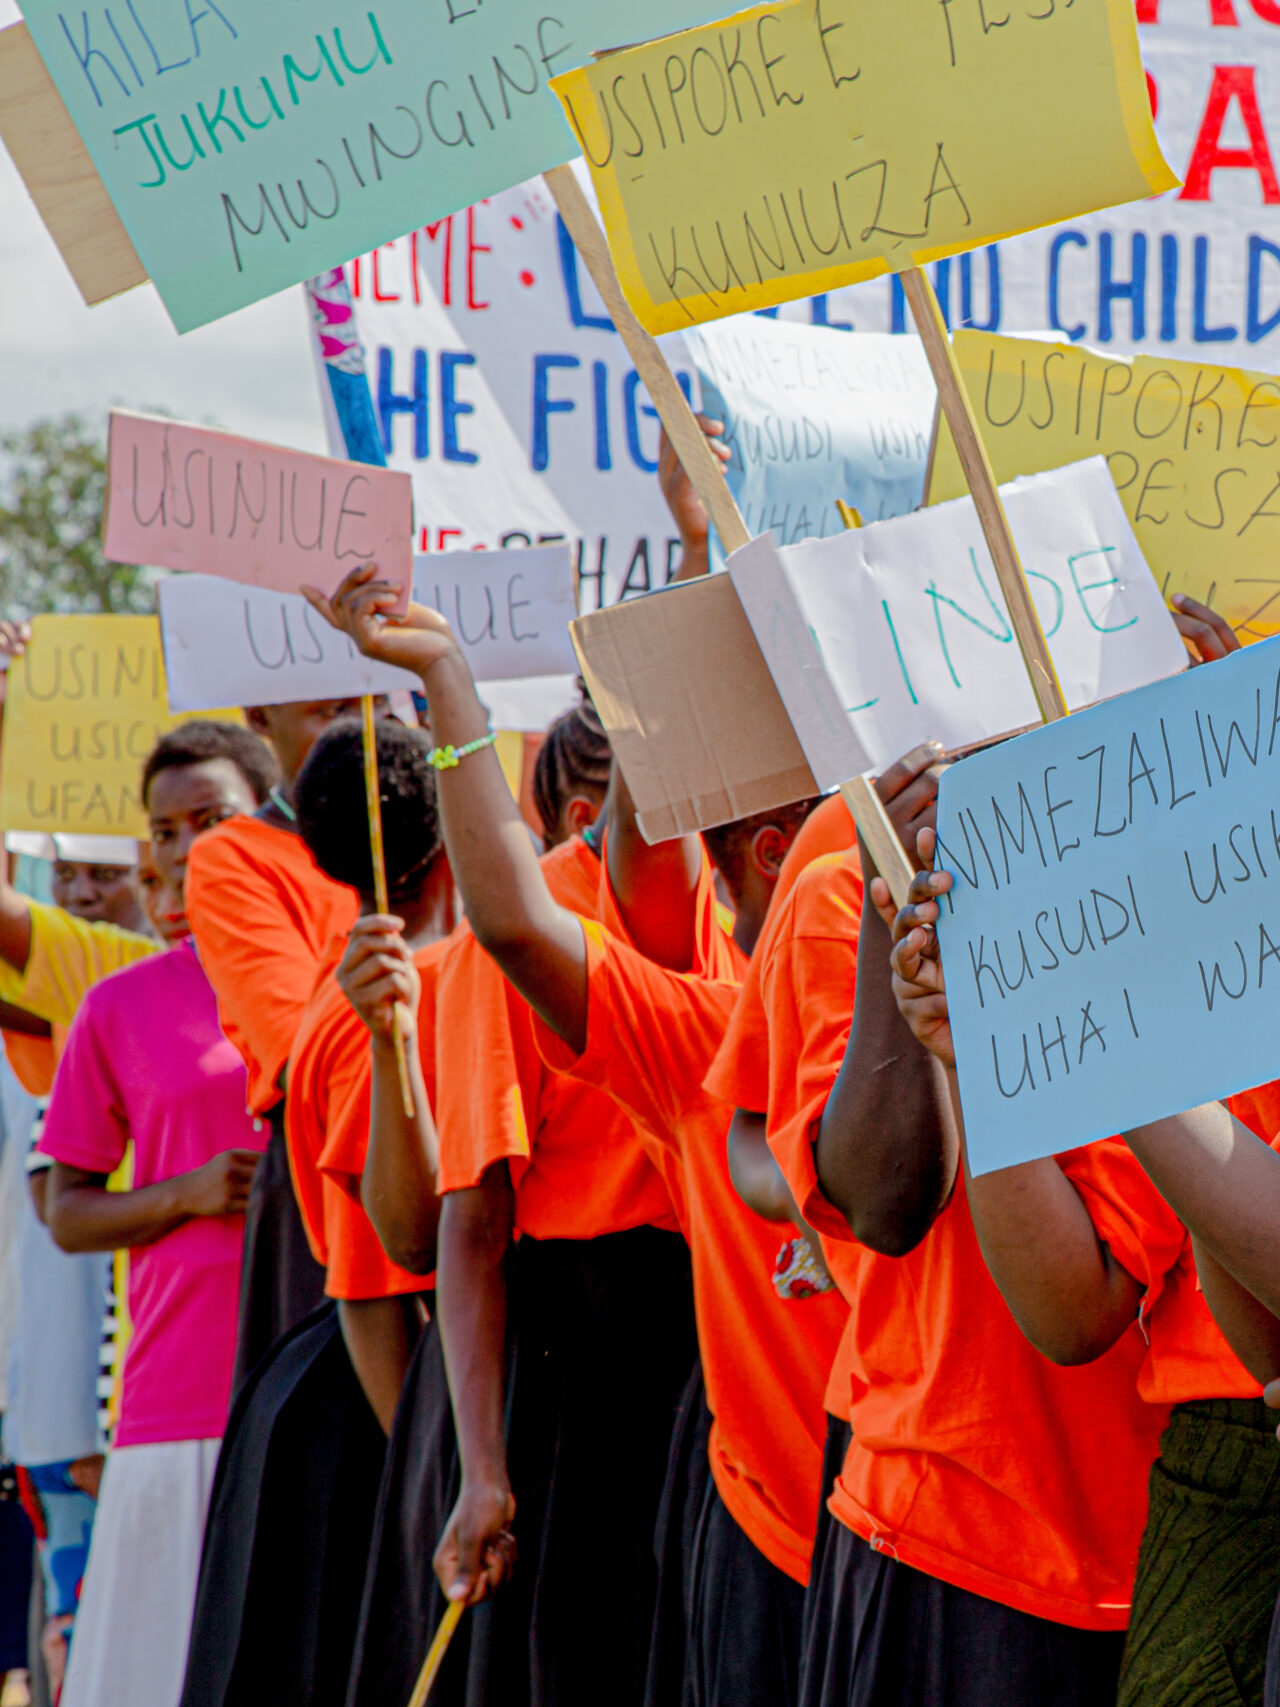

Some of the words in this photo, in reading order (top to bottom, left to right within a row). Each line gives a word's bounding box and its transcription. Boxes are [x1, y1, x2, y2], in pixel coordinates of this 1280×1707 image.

[57, 0, 239, 107] KILA
[112, 11, 394, 188] JUKUMU
[647, 142, 972, 321] KUNIUZA
[967, 874, 1145, 1009] KUSUDI
